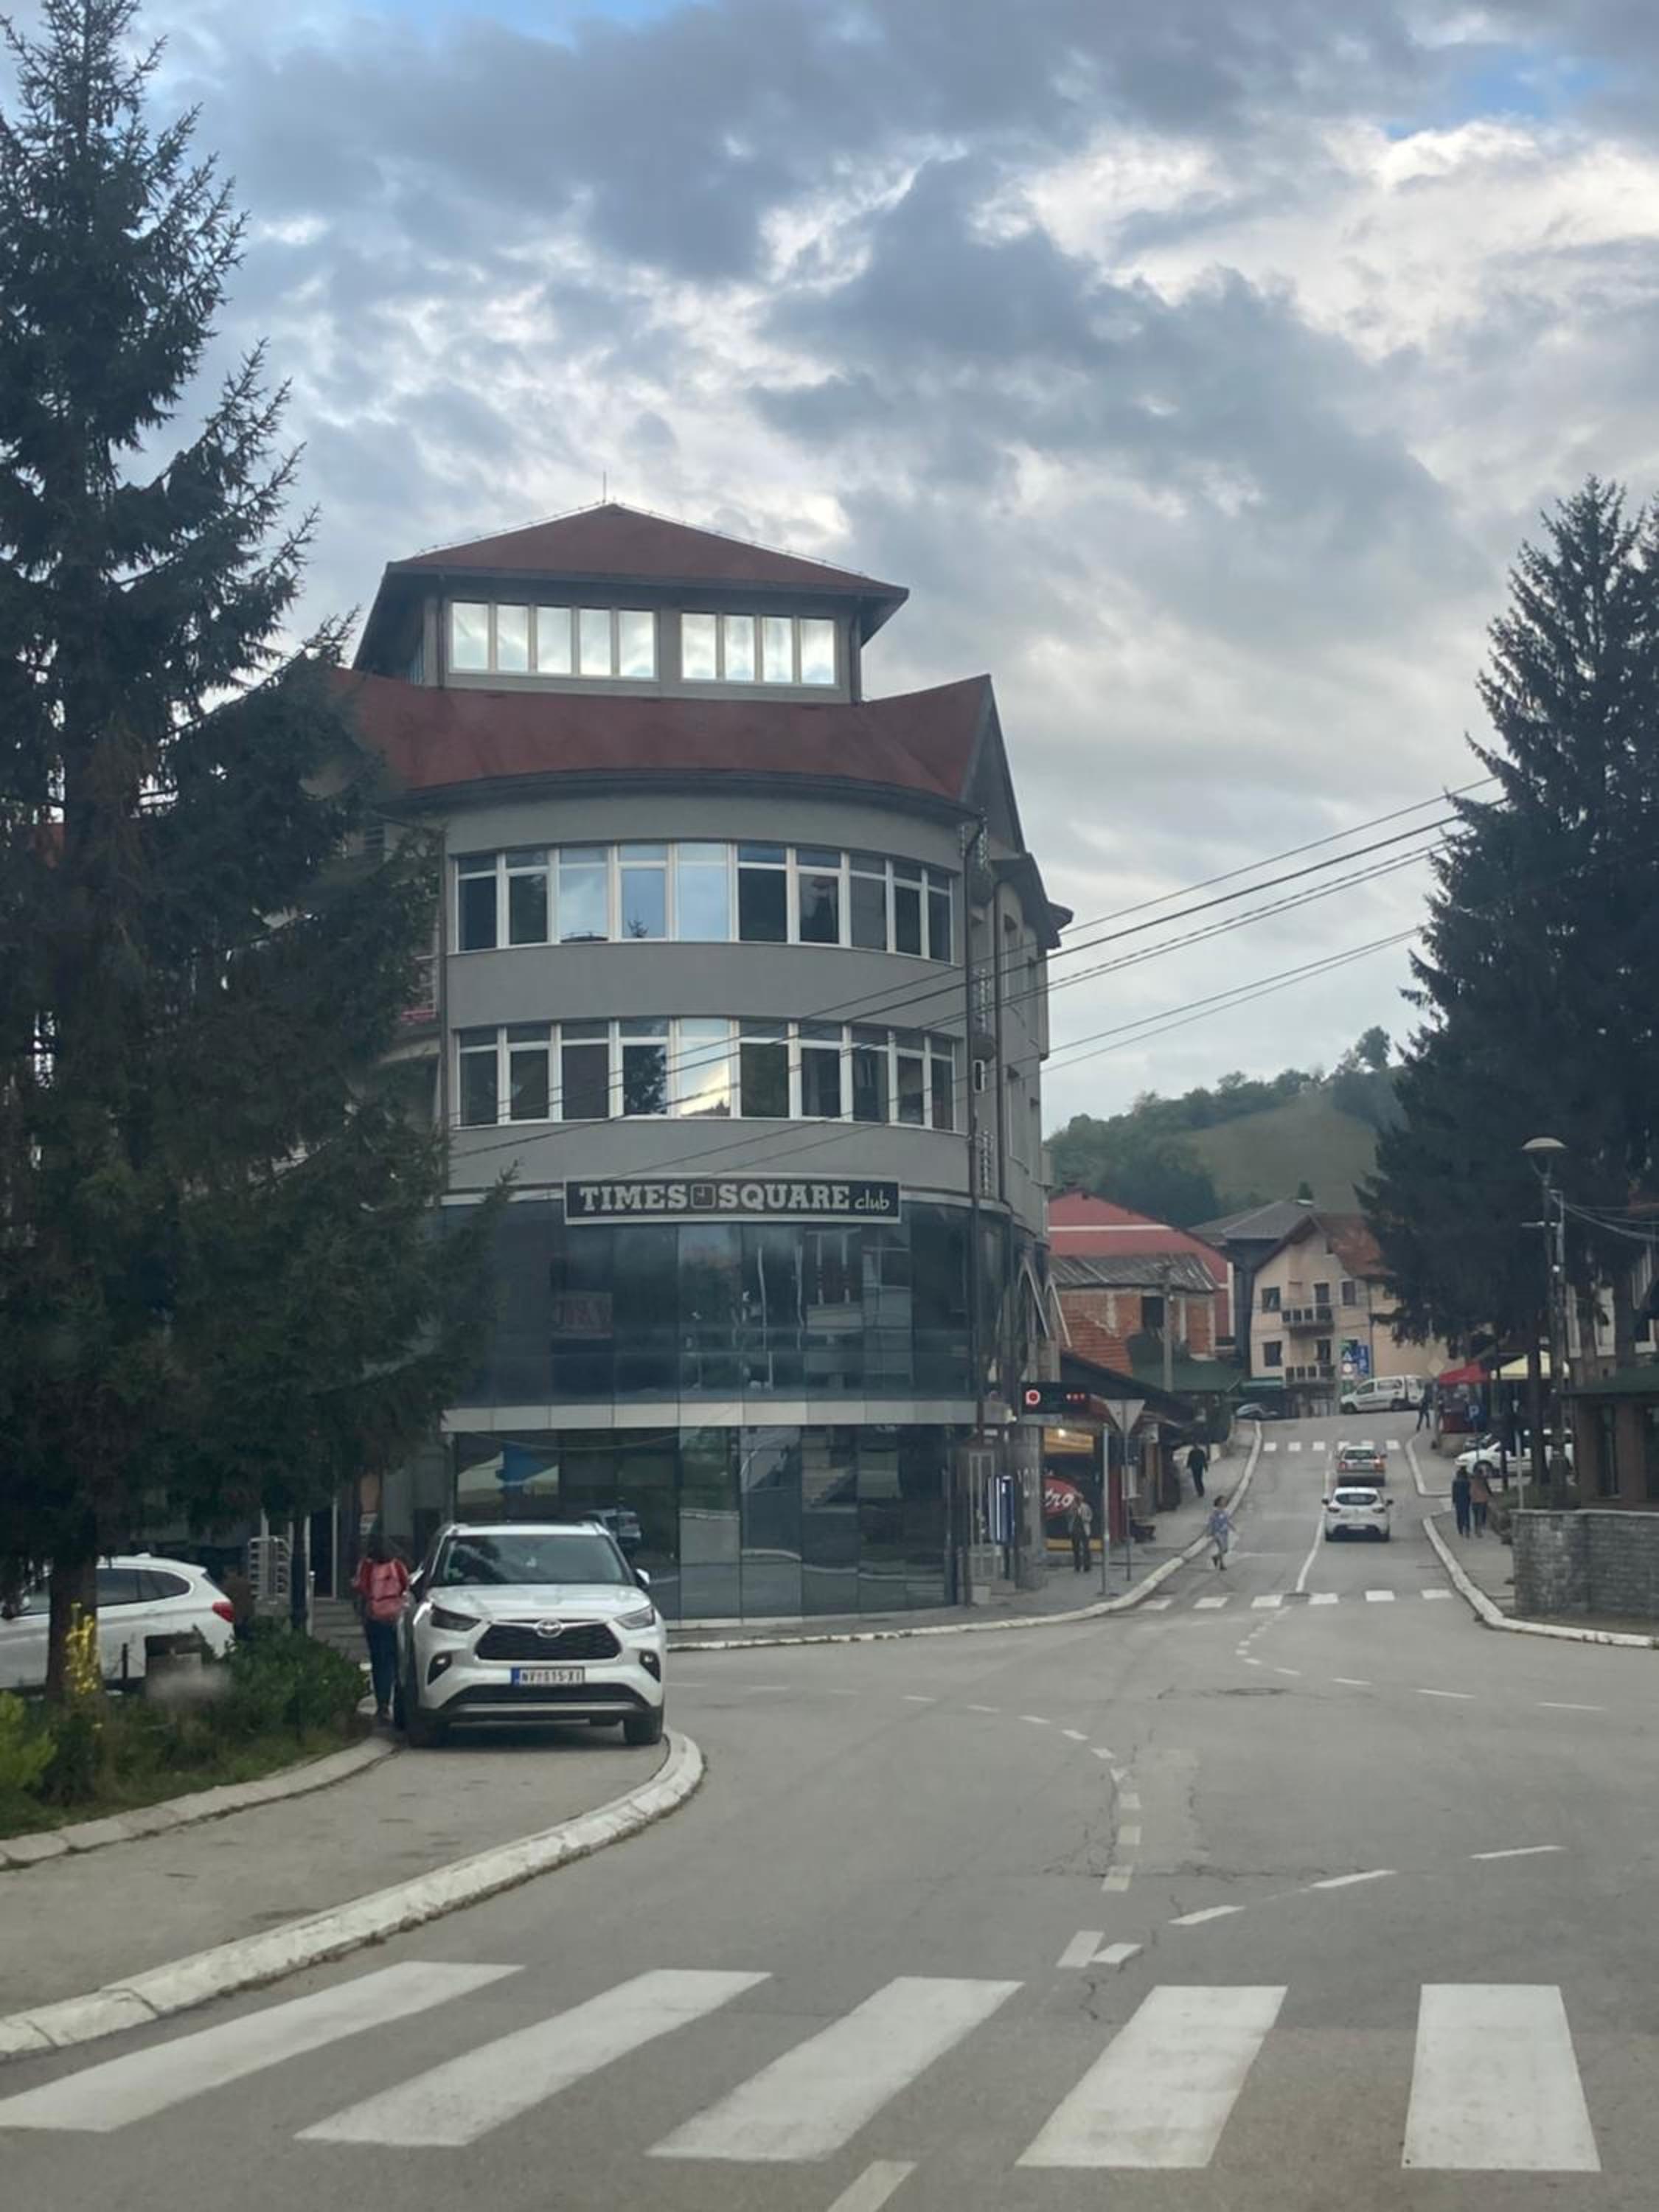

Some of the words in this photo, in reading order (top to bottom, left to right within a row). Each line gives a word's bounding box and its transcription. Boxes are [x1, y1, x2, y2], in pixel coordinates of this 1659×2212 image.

[579, 1184, 688, 1211] TIMES
[718, 1183, 850, 1211] SQUARE
[855, 1189, 891, 1211] club
